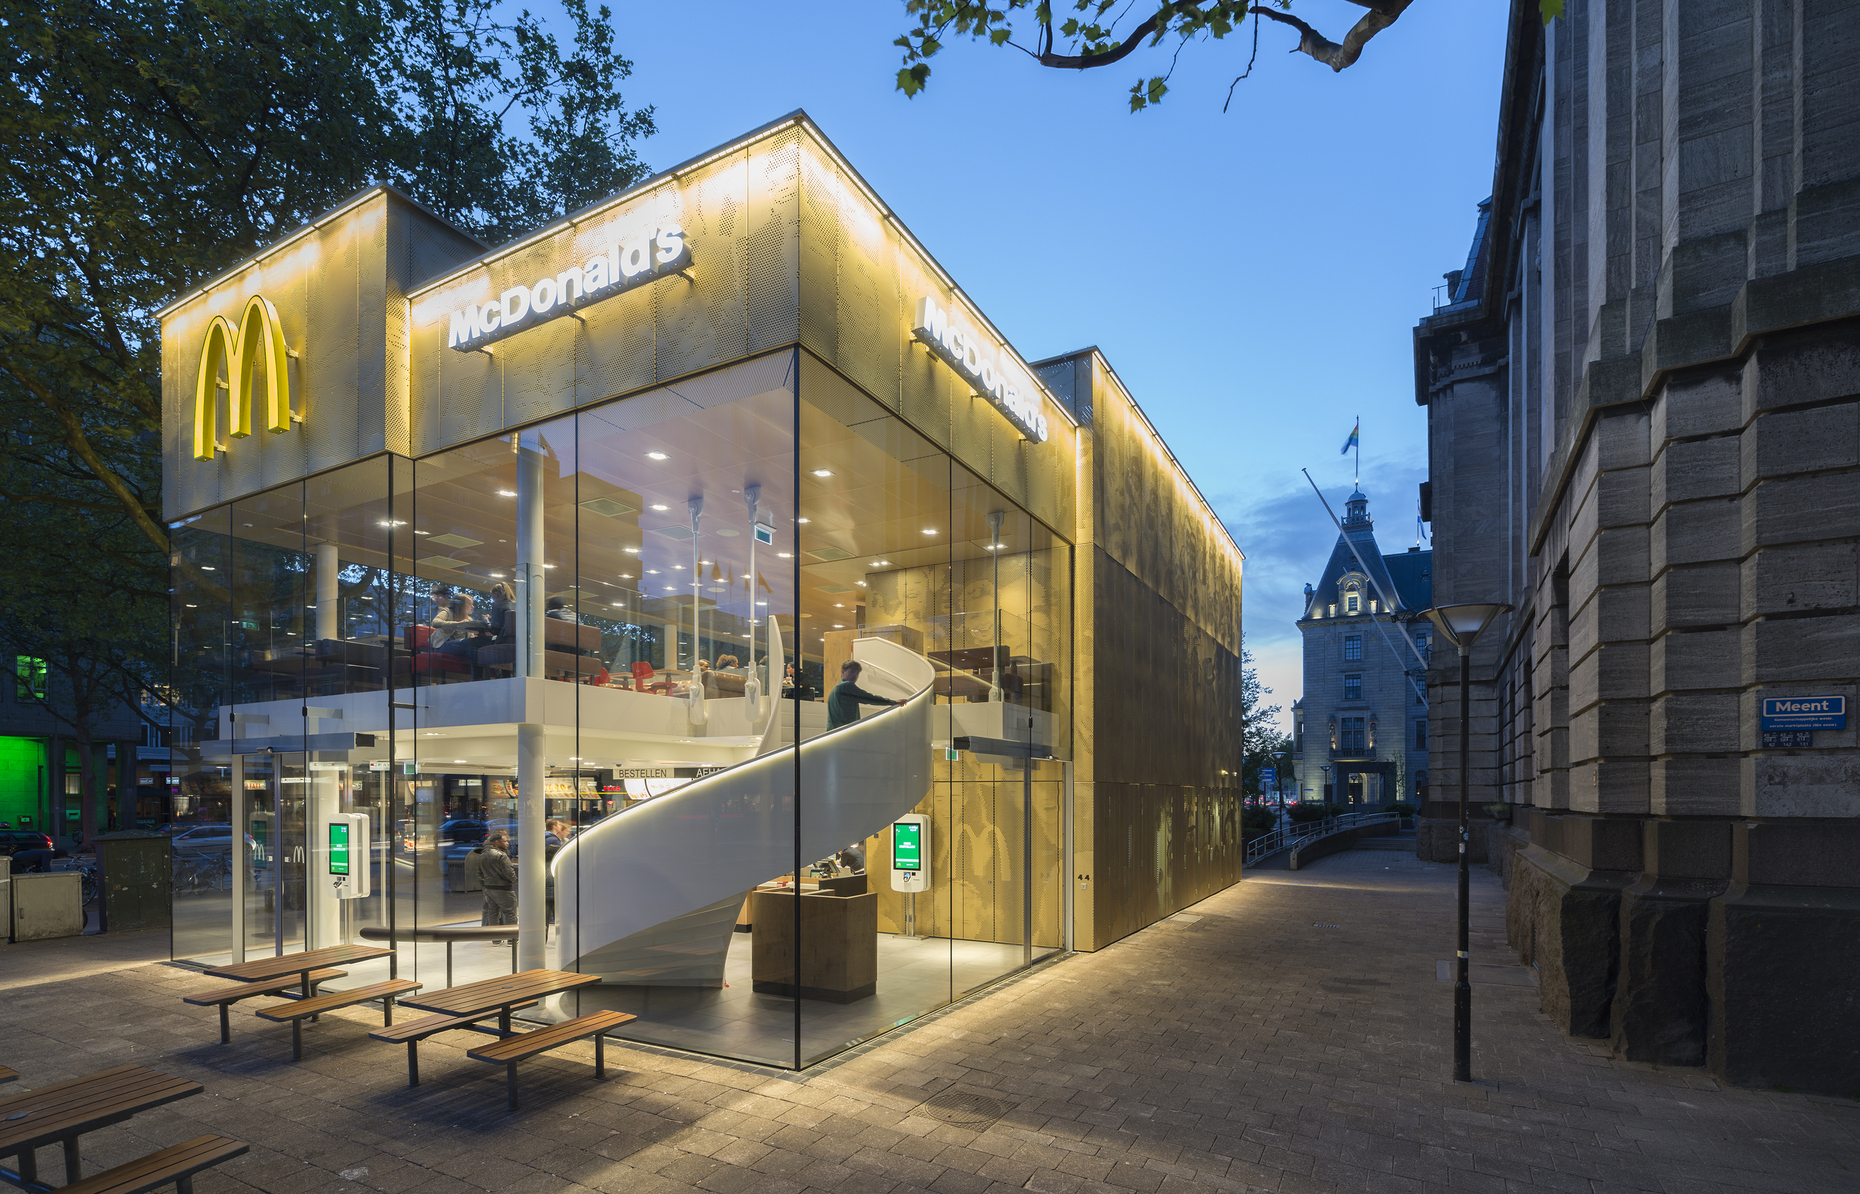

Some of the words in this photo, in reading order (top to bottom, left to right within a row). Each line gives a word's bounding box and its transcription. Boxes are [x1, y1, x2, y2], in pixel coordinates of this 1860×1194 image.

[448, 223, 688, 349] McDonald's
[919, 295, 1048, 442] McDonald's
[1775, 700, 1829, 712] Meent
[618, 768, 667, 779] BESTELLEN
